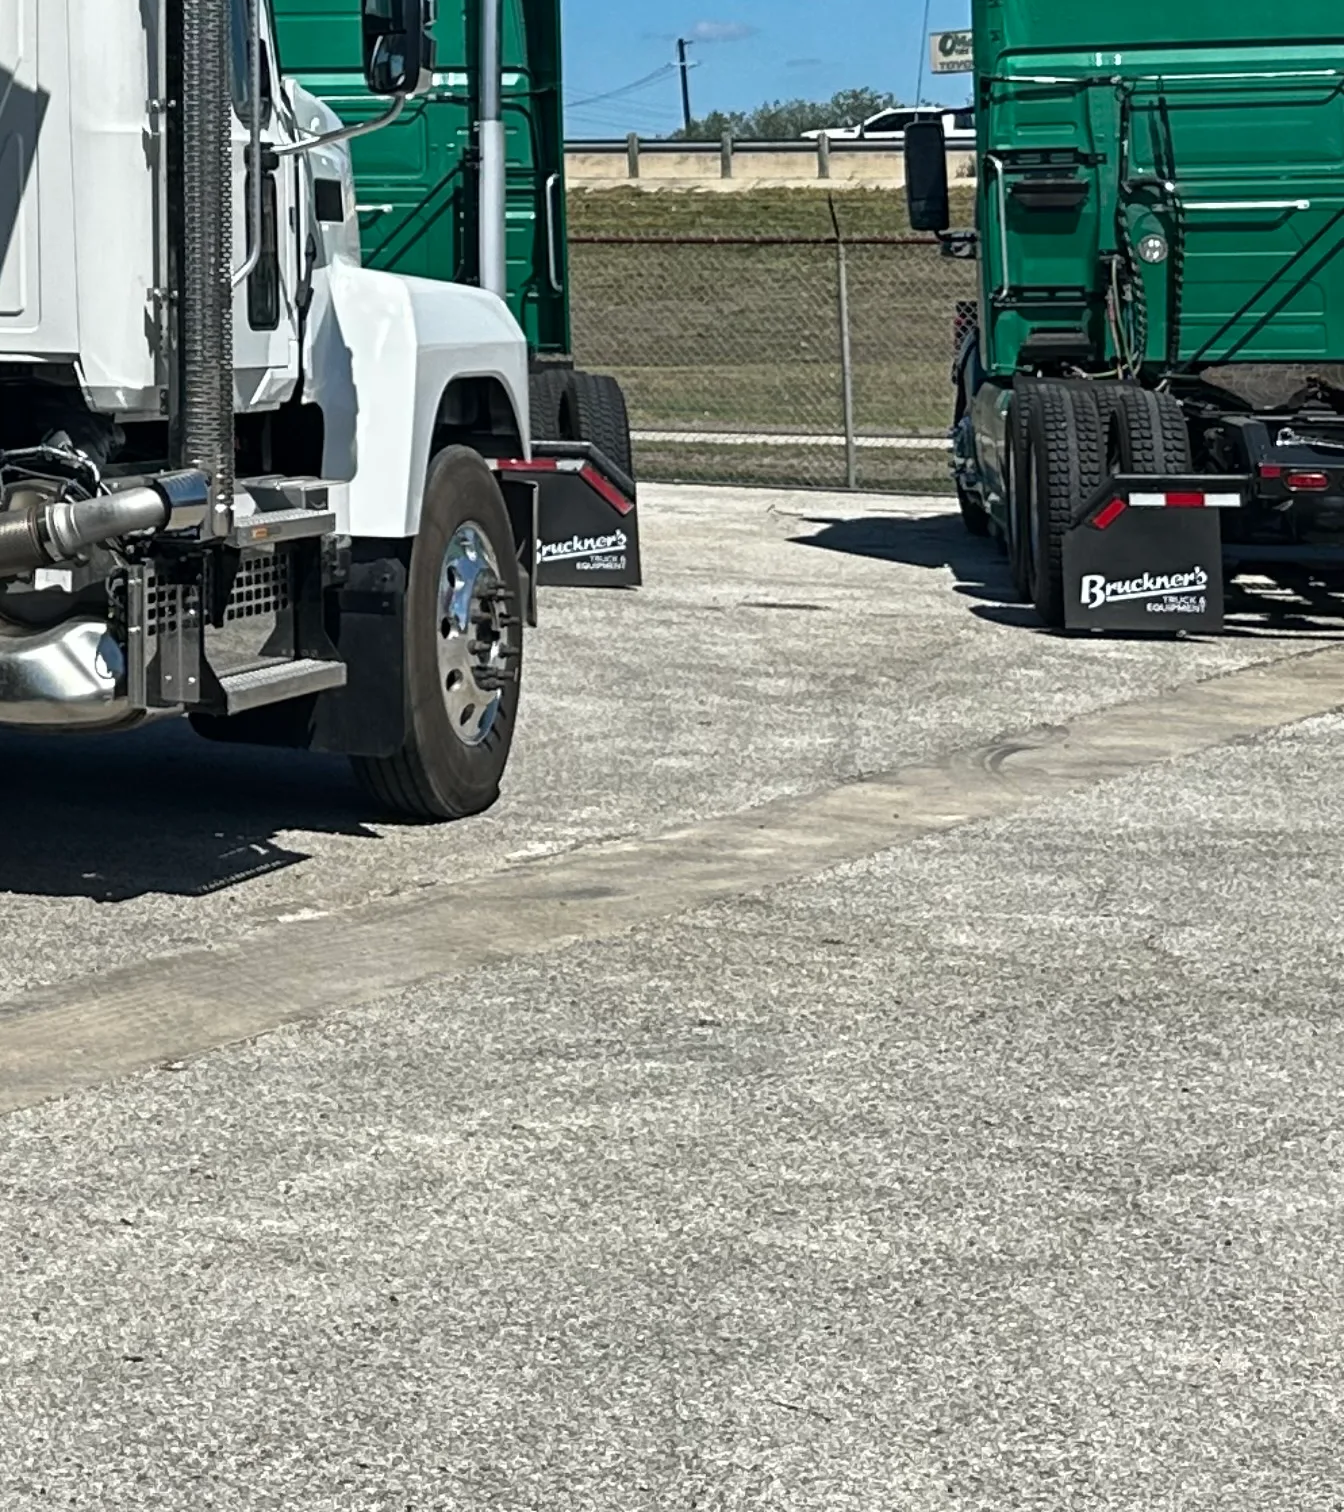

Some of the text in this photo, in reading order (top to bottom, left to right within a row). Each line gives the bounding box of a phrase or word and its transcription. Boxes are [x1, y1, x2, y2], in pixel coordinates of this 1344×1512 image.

[536, 529, 627, 565] ruckner's
[1080, 565, 1208, 609] Bruckner's
[1146, 602, 1206, 613] EQUIPMENT
